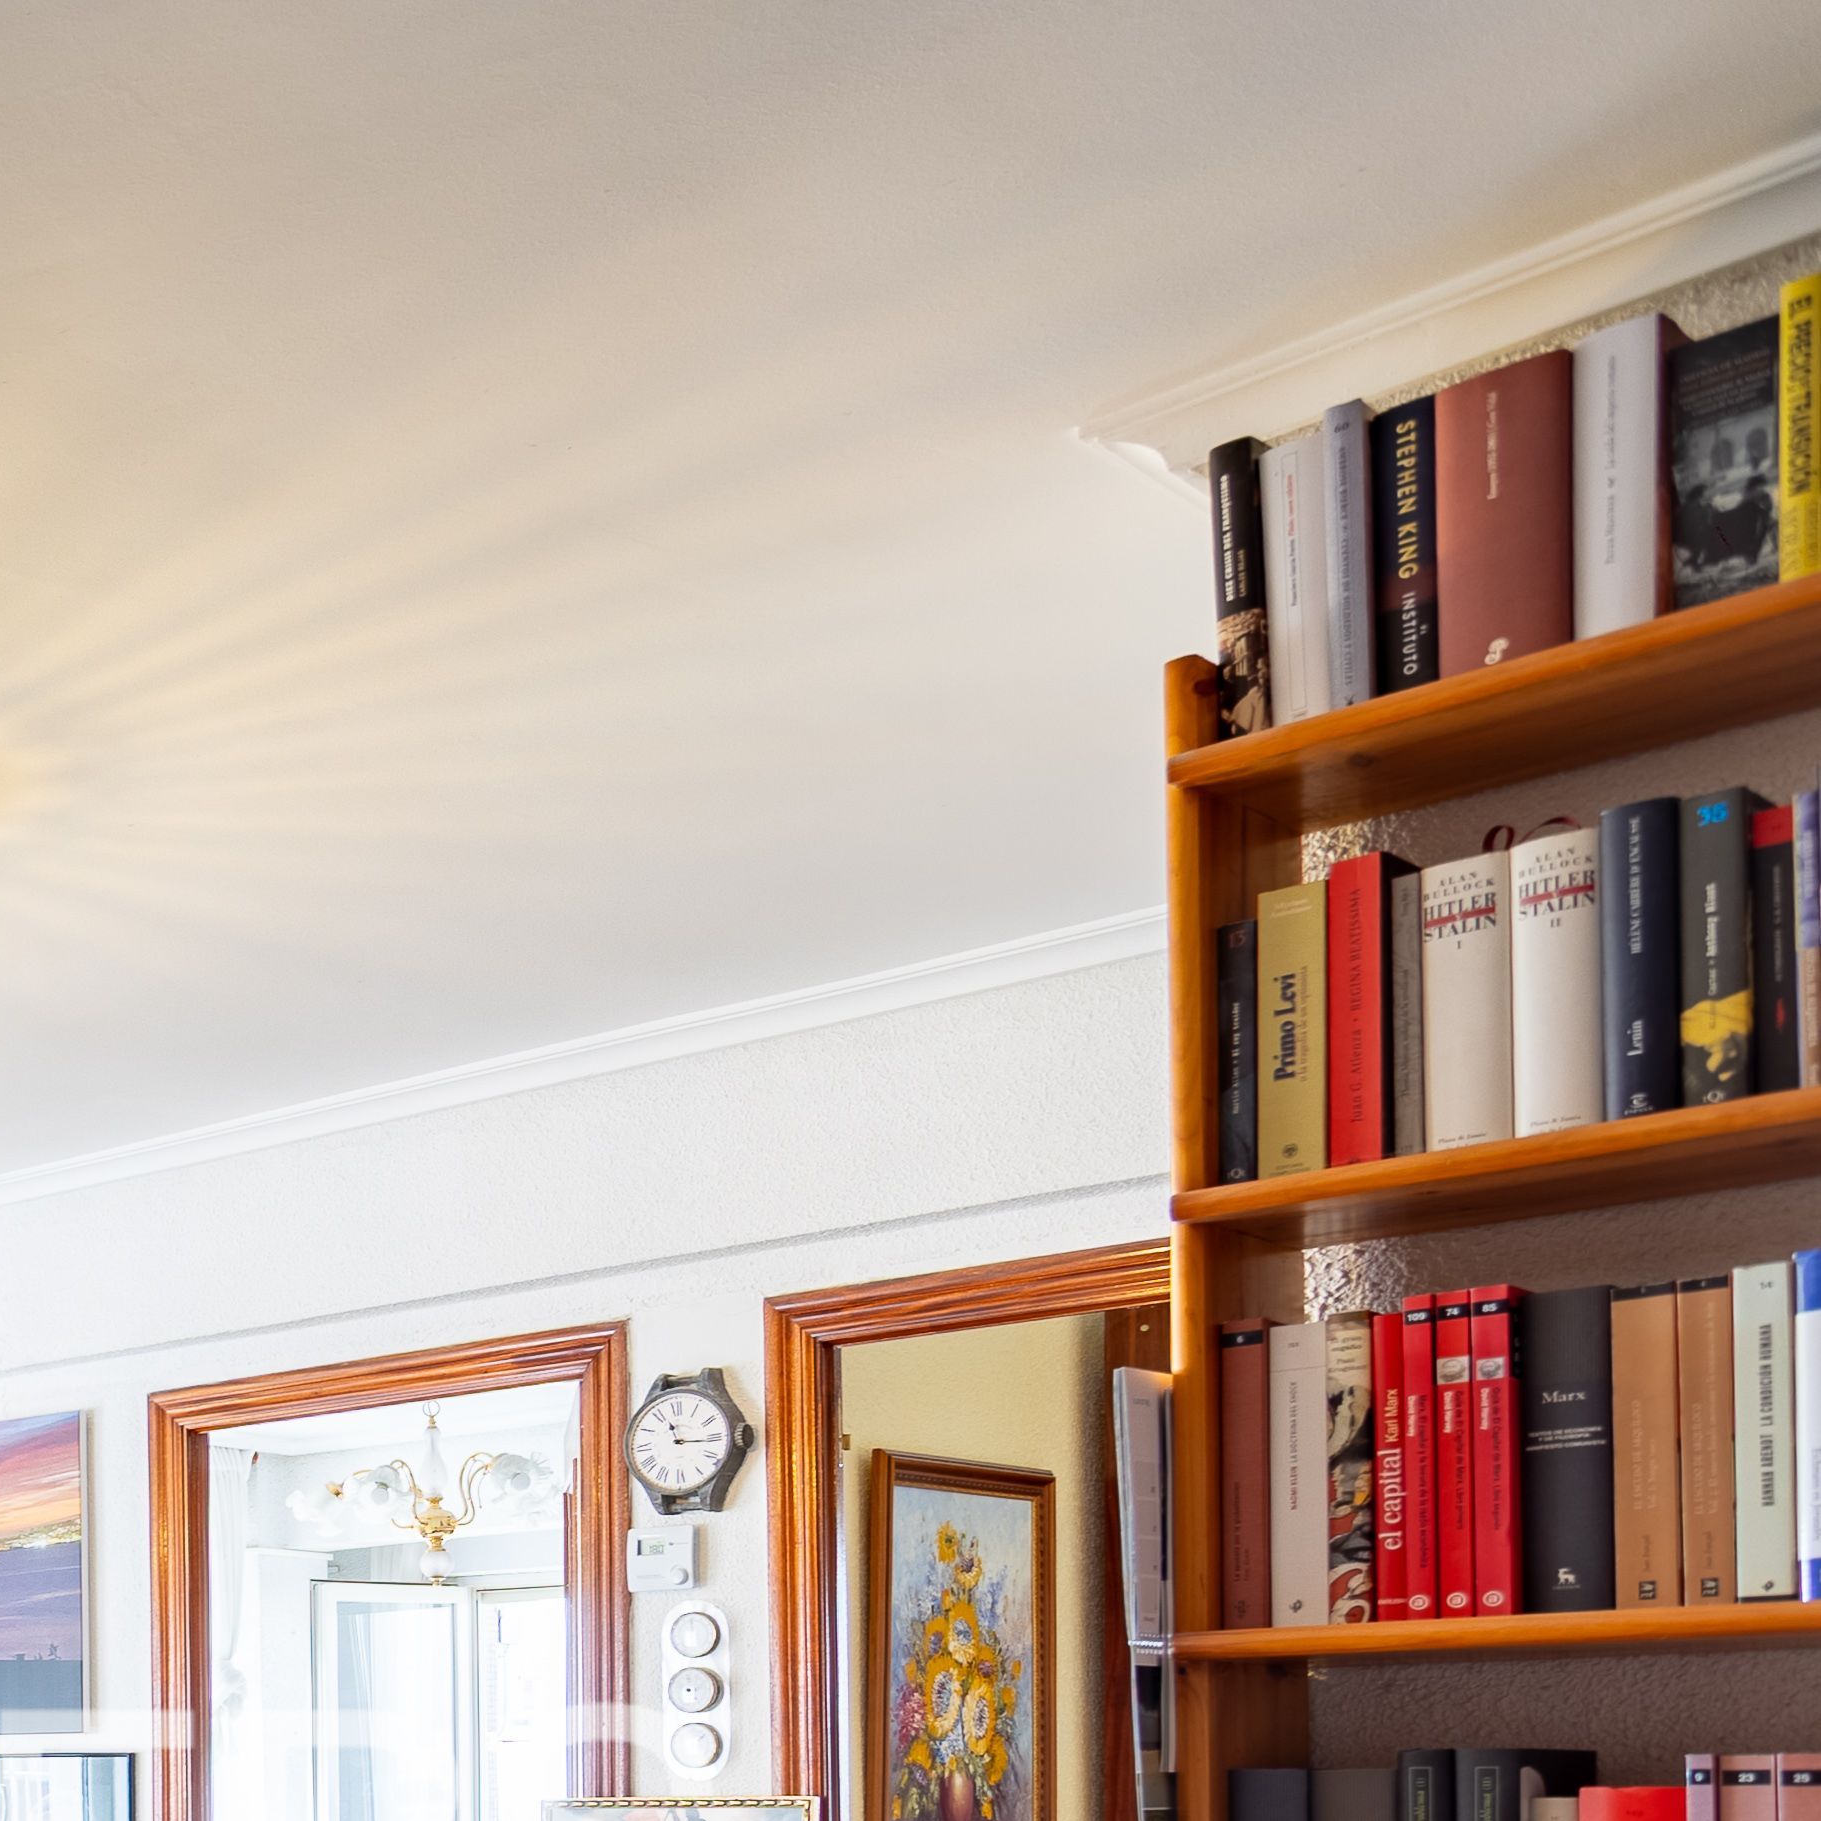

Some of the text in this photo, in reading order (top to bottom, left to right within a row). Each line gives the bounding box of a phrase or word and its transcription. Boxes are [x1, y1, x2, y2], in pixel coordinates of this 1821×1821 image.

[1396, 419, 1419, 579] STEPHEN KING
[1402, 592, 1428, 675] EL INSTITUTO
[1519, 856, 1593, 877] BULLOCK
[1536, 846, 1575, 863] ALAN
[1423, 878, 1495, 903] BULLOCK
[1440, 871, 1477, 886] ALAN
[1519, 869, 1595, 902] HITLER
[1424, 892, 1496, 923] HITLER
[1519, 893, 1595, 920] STALIN
[1423, 916, 1496, 943] STALIN
[1349, 889, 1364, 1123] Juan G. Atienza REGINA BEATISSIMA
[1273, 972, 1297, 1082] Primo Levi
[1626, 1019, 1645, 1056] Lenin
[1407, 1311, 1425, 1322] 109
[1446, 1307, 1459, 1317] 74
[1482, 1303, 1497, 1313] 85
[1542, 1390, 1586, 1404] Marx
[1384, 1389, 1400, 1443] Karl Marx
[1759, 1324, 1774, 1506] HANNAH ARENDT LA CONDICIÓN HUMANA
[1377, 1448, 1403, 1550] el capital
[1737, 1772, 1754, 1784] 23
